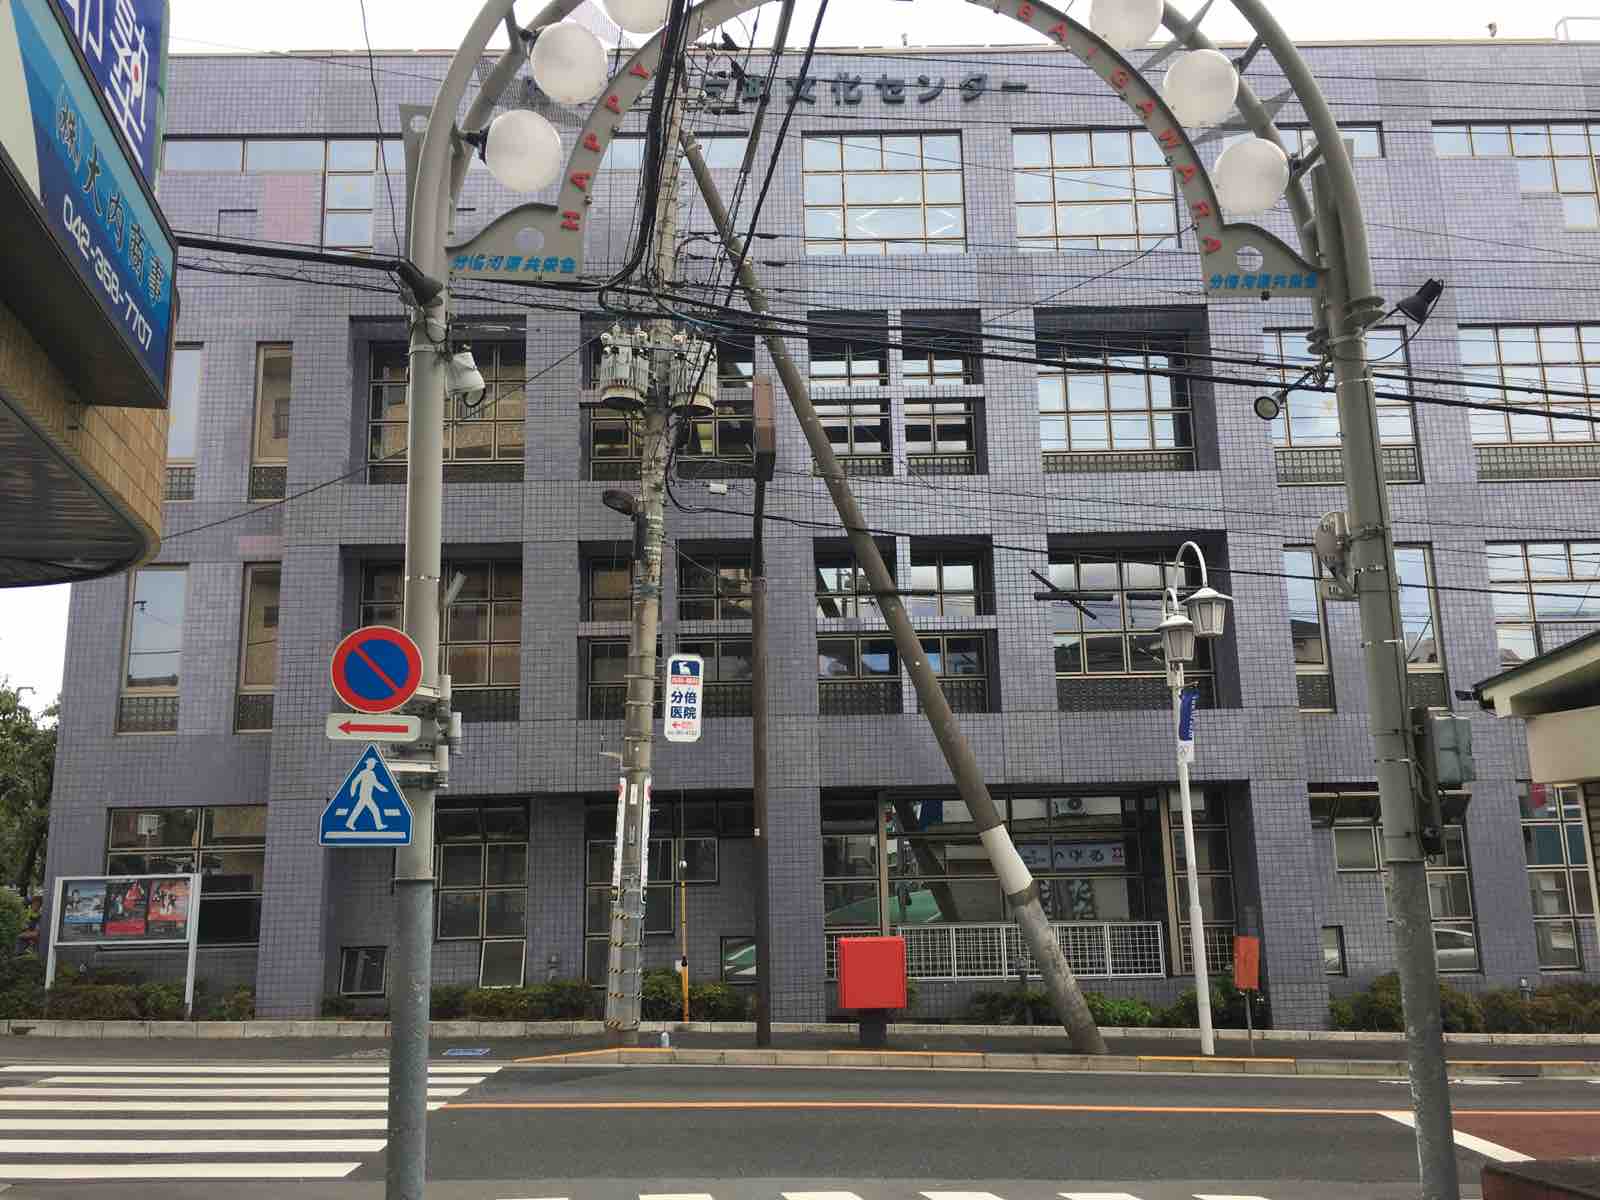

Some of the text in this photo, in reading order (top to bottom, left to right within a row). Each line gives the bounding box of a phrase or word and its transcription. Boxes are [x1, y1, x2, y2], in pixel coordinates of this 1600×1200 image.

[560, 62, 650, 232] HAPPY
[671, 690, 697, 704] 分倍
[671, 706, 697, 720] 医院
